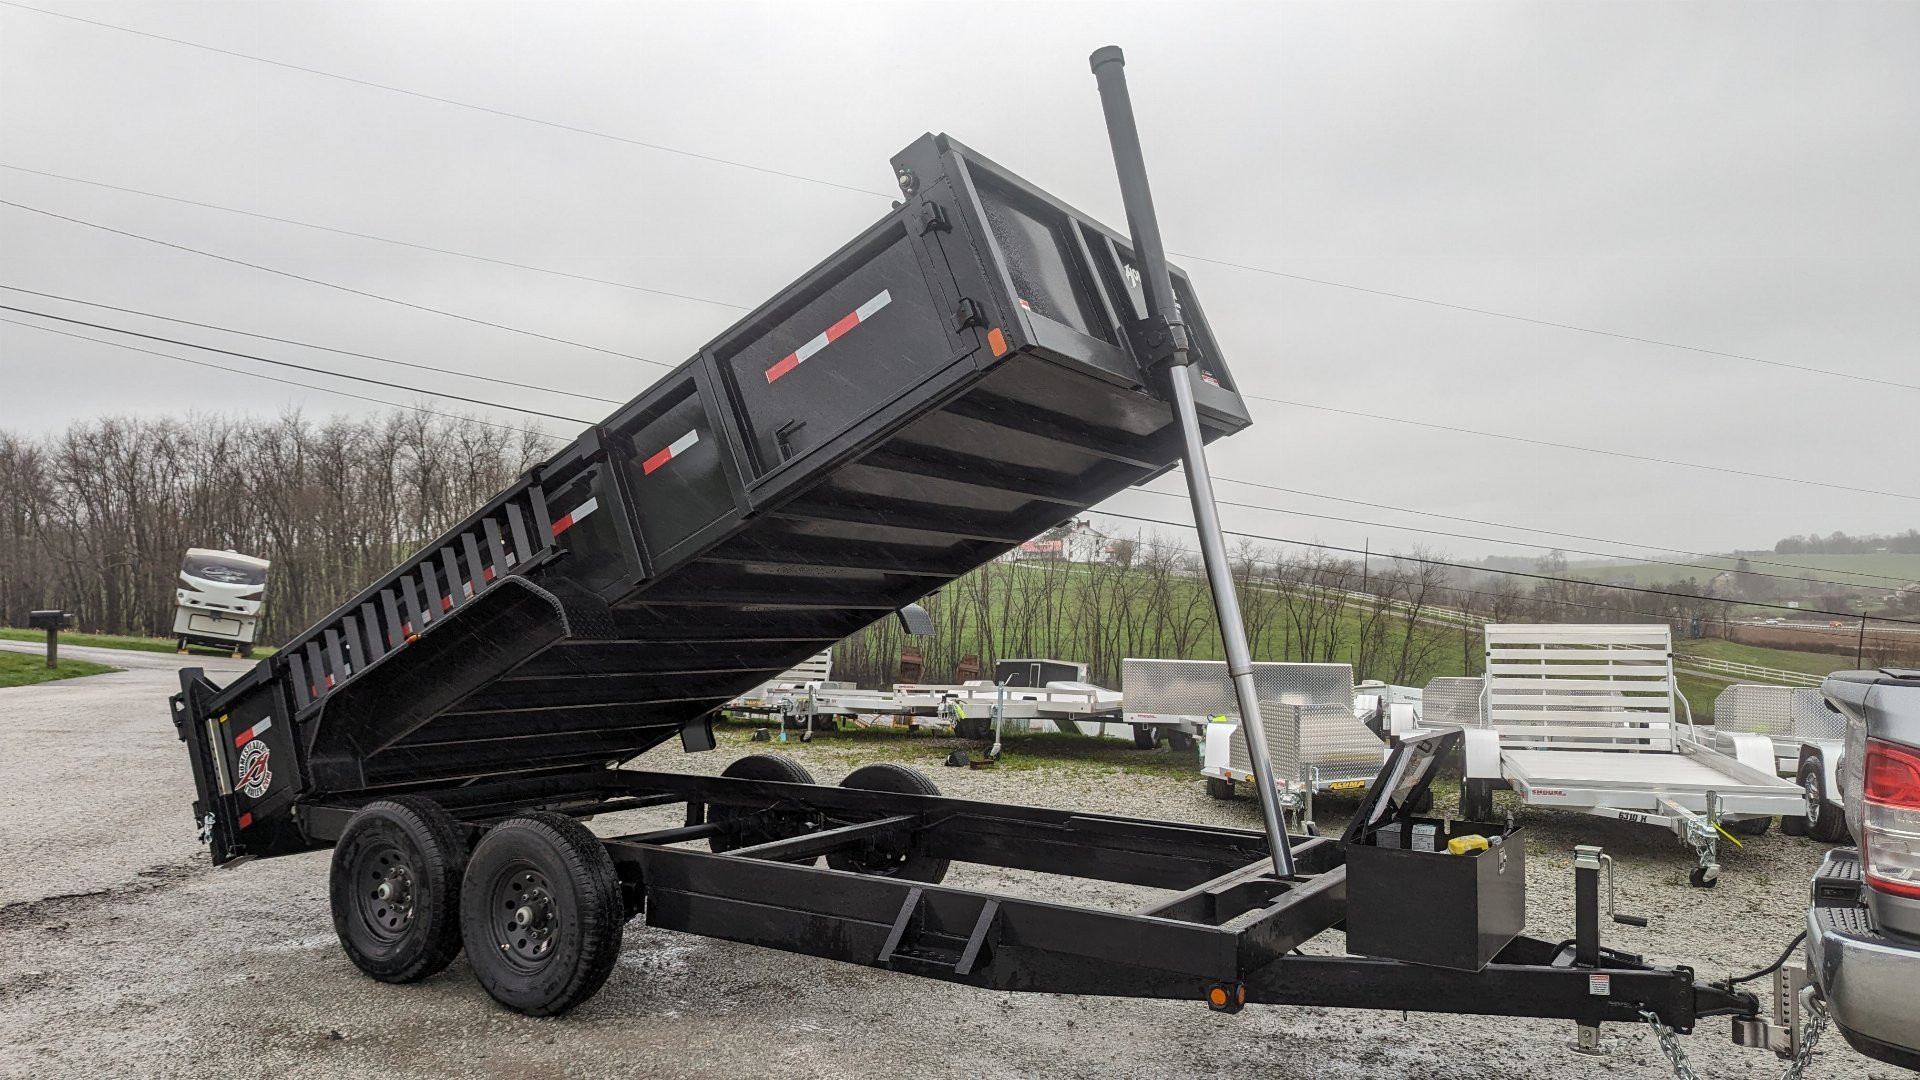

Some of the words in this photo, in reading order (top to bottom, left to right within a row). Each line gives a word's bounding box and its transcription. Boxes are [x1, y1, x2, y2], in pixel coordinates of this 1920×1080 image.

[1329, 780, 1365, 790] ALUMA
[1618, 811, 1638, 822] 6310
[1640, 815, 1648, 823] H
